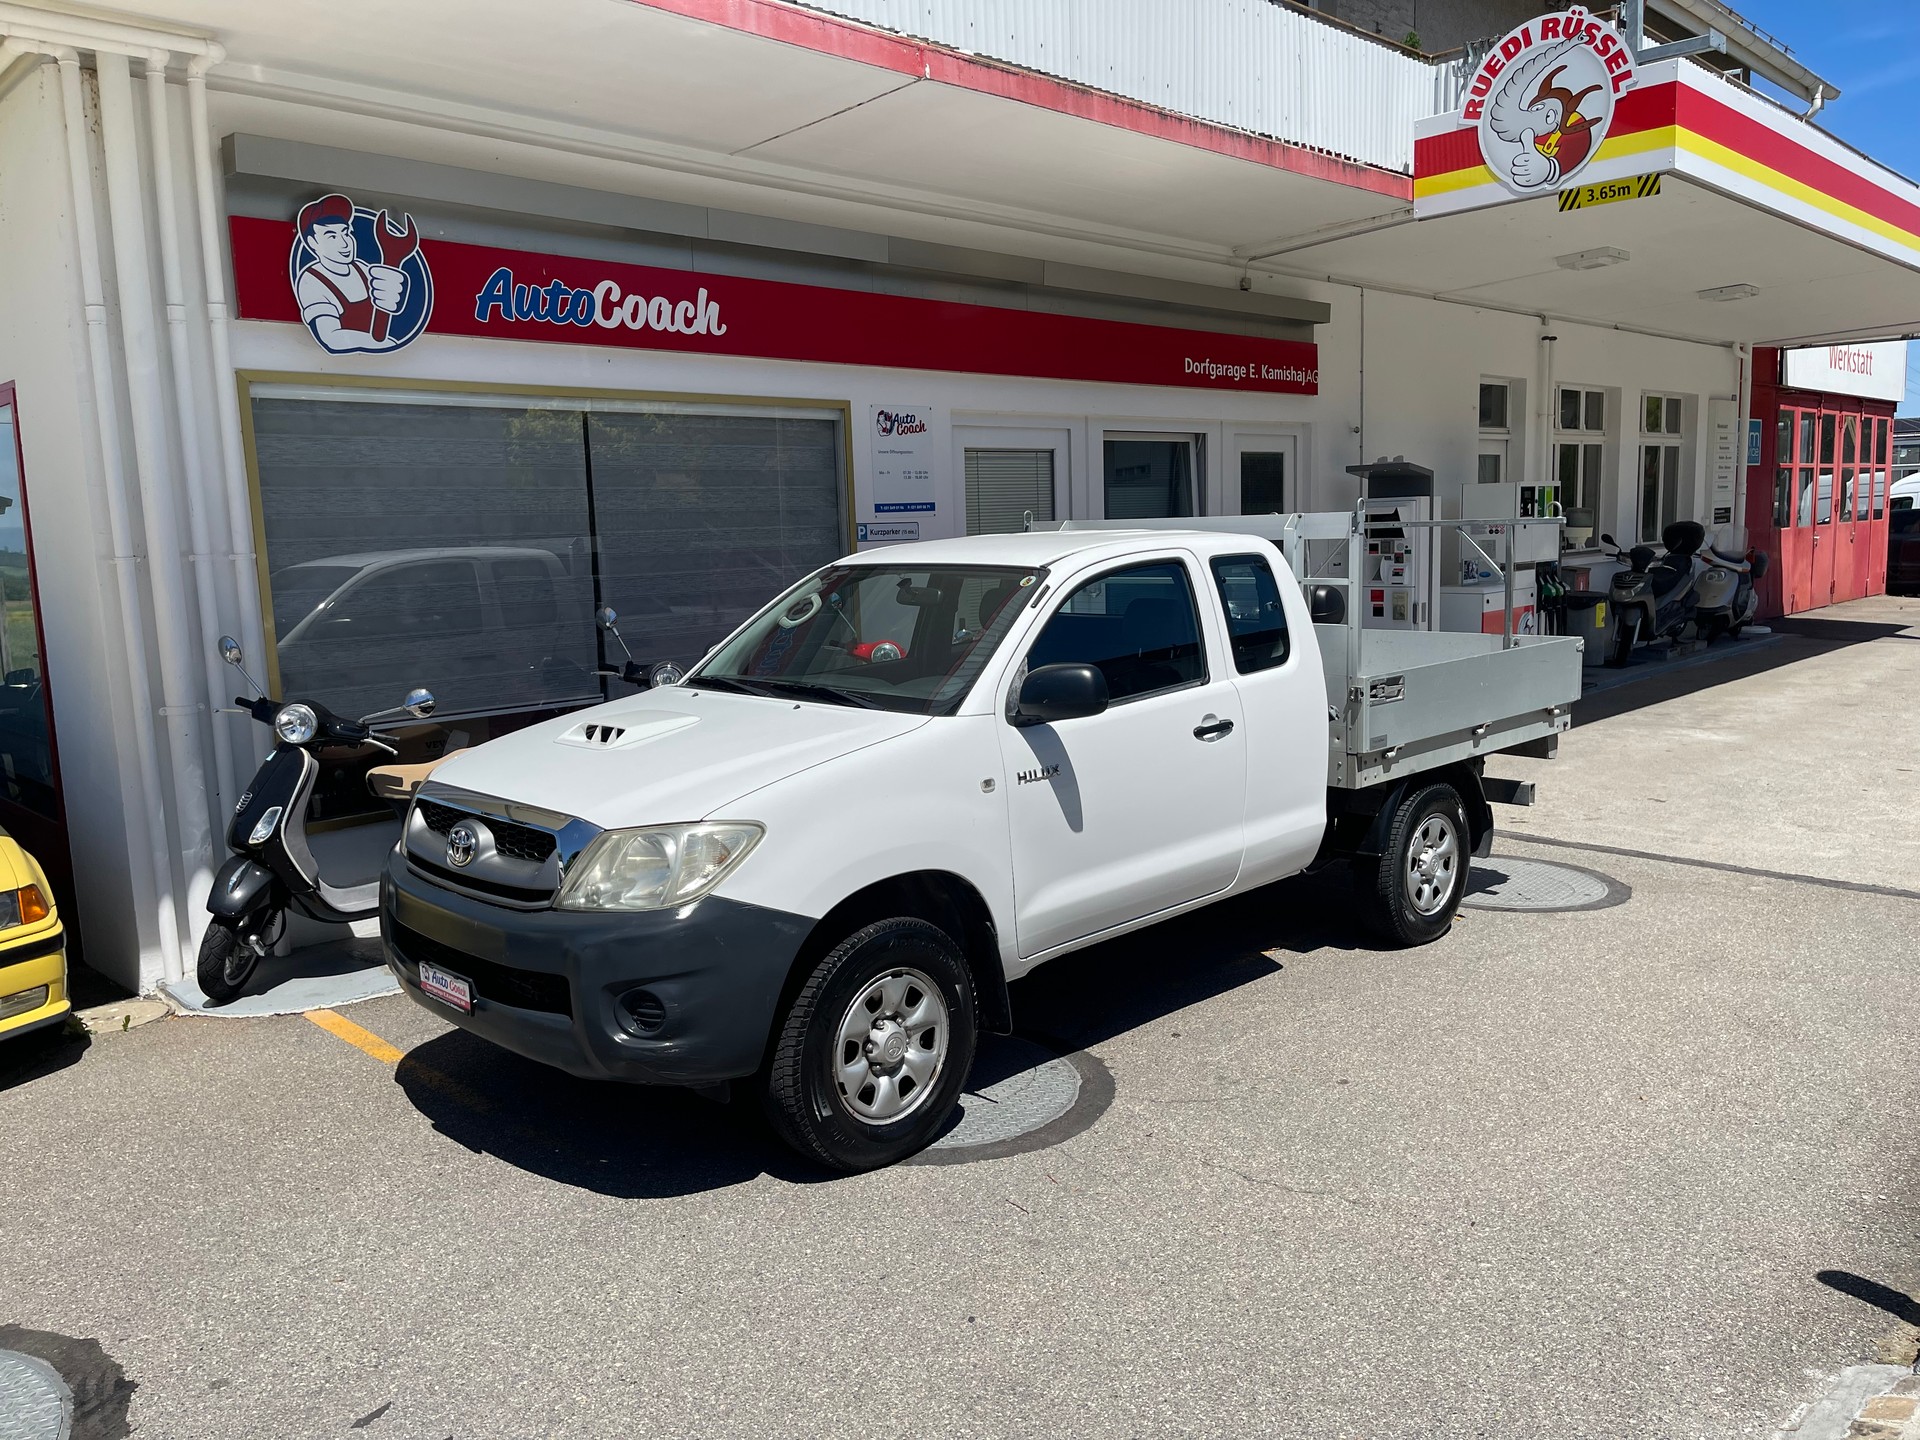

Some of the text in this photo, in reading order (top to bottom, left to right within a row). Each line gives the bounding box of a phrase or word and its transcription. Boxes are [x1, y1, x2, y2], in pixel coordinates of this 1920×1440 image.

[1463, 9, 1633, 120] RUEDI RÜSSEL
[1586, 182, 1632, 203] 3.65m
[1184, 357, 1247, 381] Dorfgarage
[1249, 363, 1259, 379] E.
[1828, 344, 1873, 377] Werkstatt
[893, 413, 915, 426] Auto
[897, 420, 927, 435] Coach
[857, 526, 866, 540] P
[869, 528, 901, 537] Kurzparker
[1017, 763, 1060, 784] HILUX
[432, 971, 448, 989] Auto
